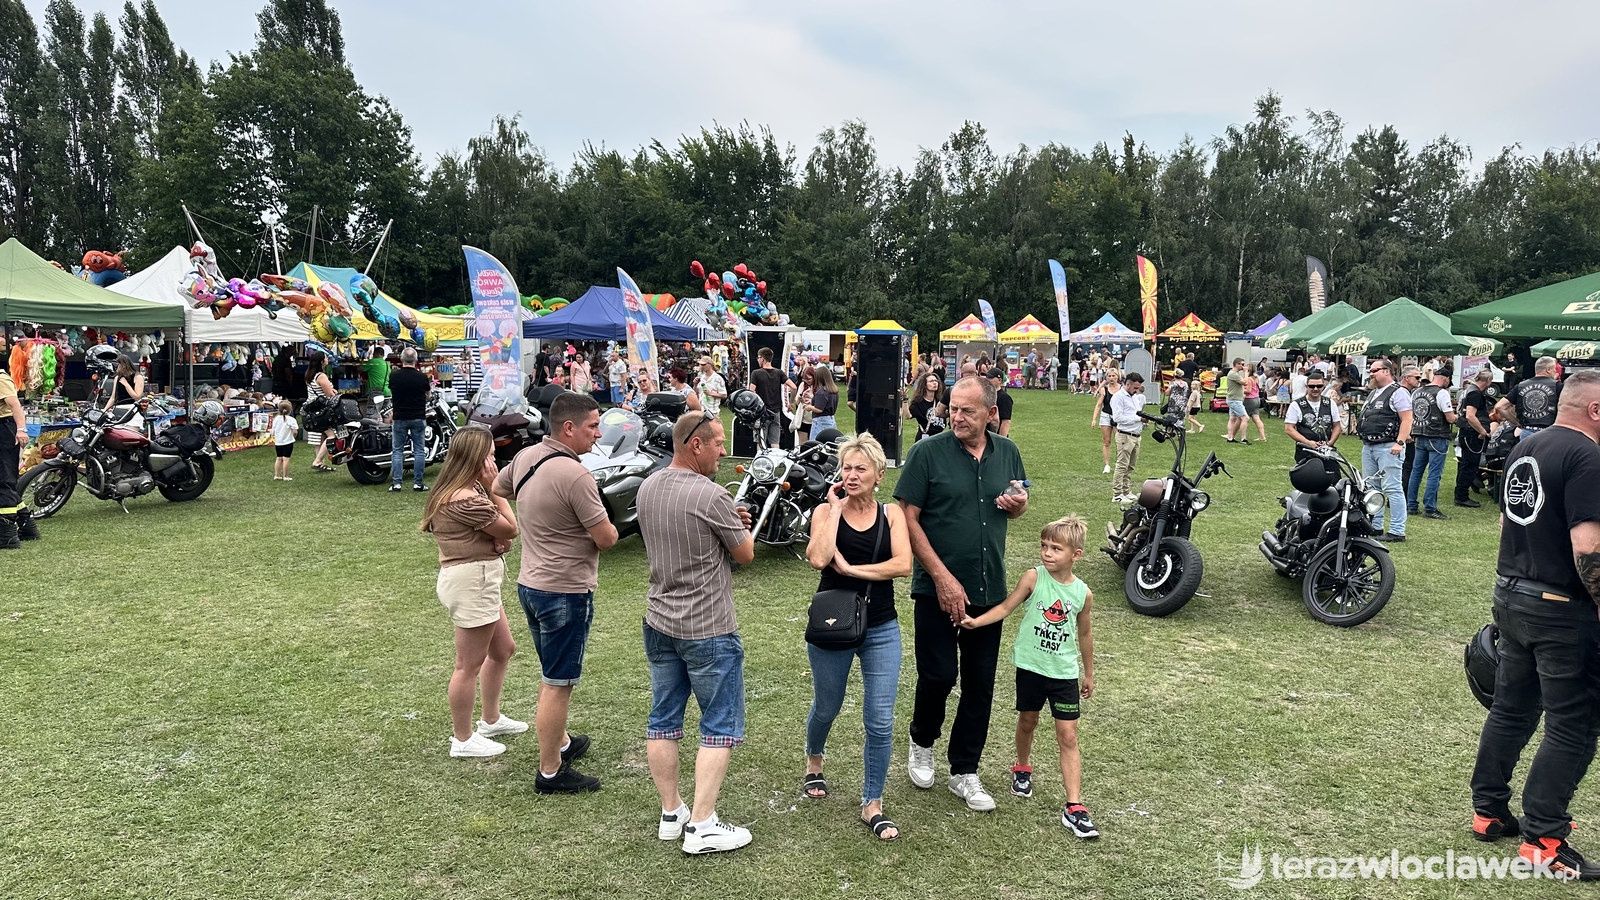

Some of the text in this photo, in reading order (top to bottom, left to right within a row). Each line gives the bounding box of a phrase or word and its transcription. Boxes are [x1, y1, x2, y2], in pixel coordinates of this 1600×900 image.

[1034, 626, 1069, 642] TAKE IT
[1041, 640, 1061, 651] EASY
